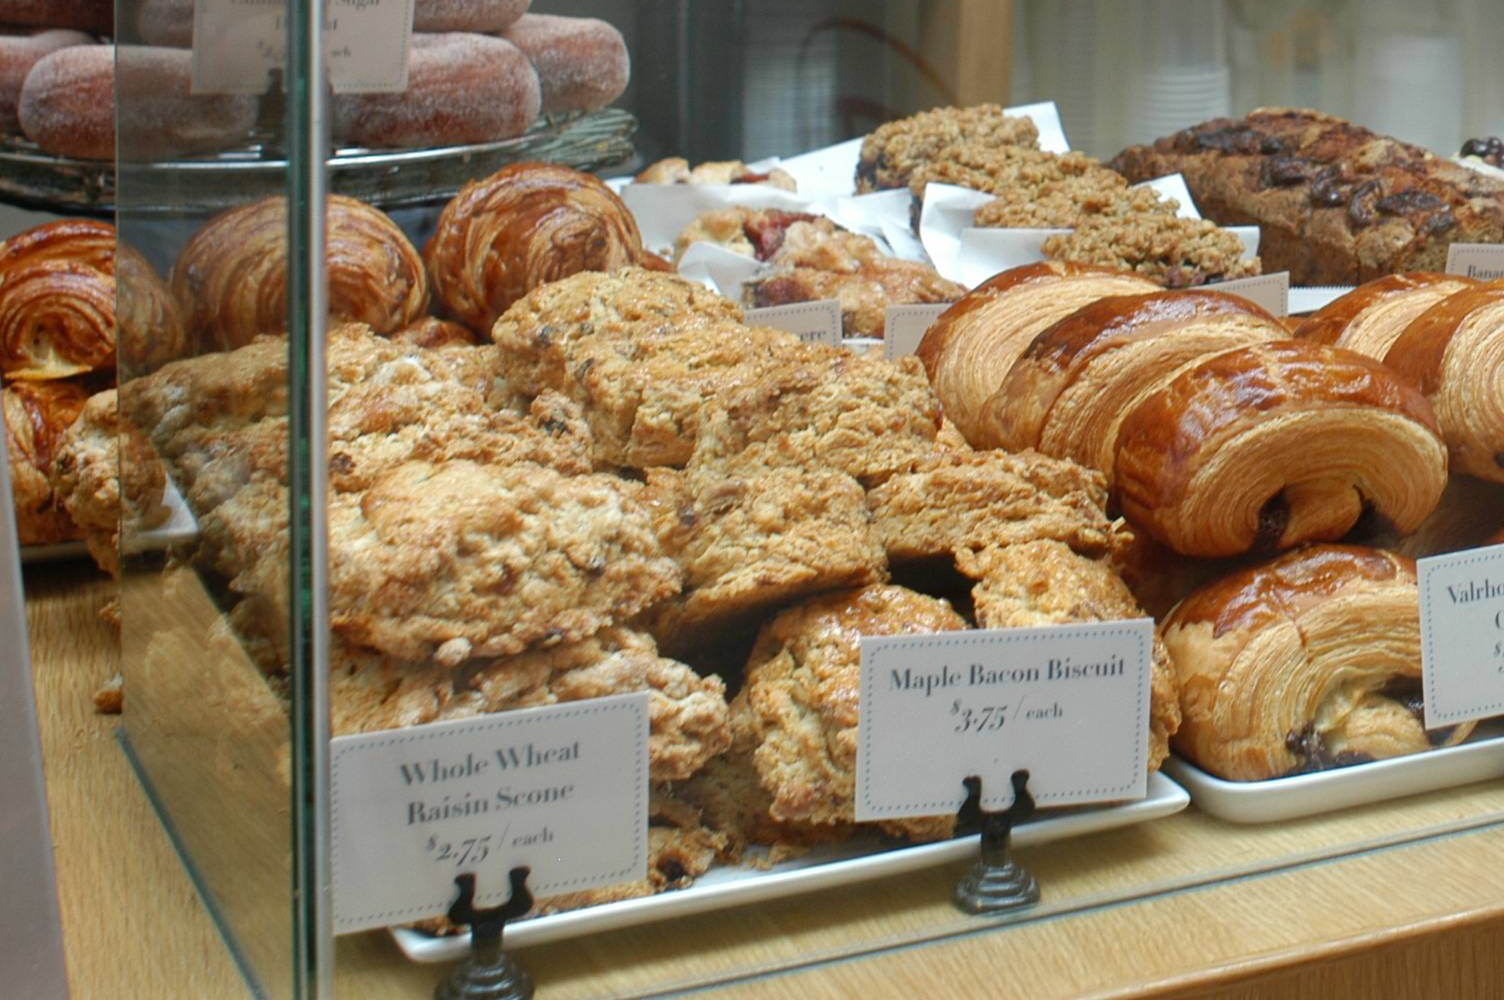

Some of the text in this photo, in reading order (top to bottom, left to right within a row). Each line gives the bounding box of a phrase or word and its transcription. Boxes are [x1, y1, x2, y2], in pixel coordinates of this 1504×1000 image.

[888, 653, 1126, 697] Maple Bacon Biscuit
[399, 741, 581, 787] Whole Wheat
[407, 781, 575, 825] Raisin Scone
